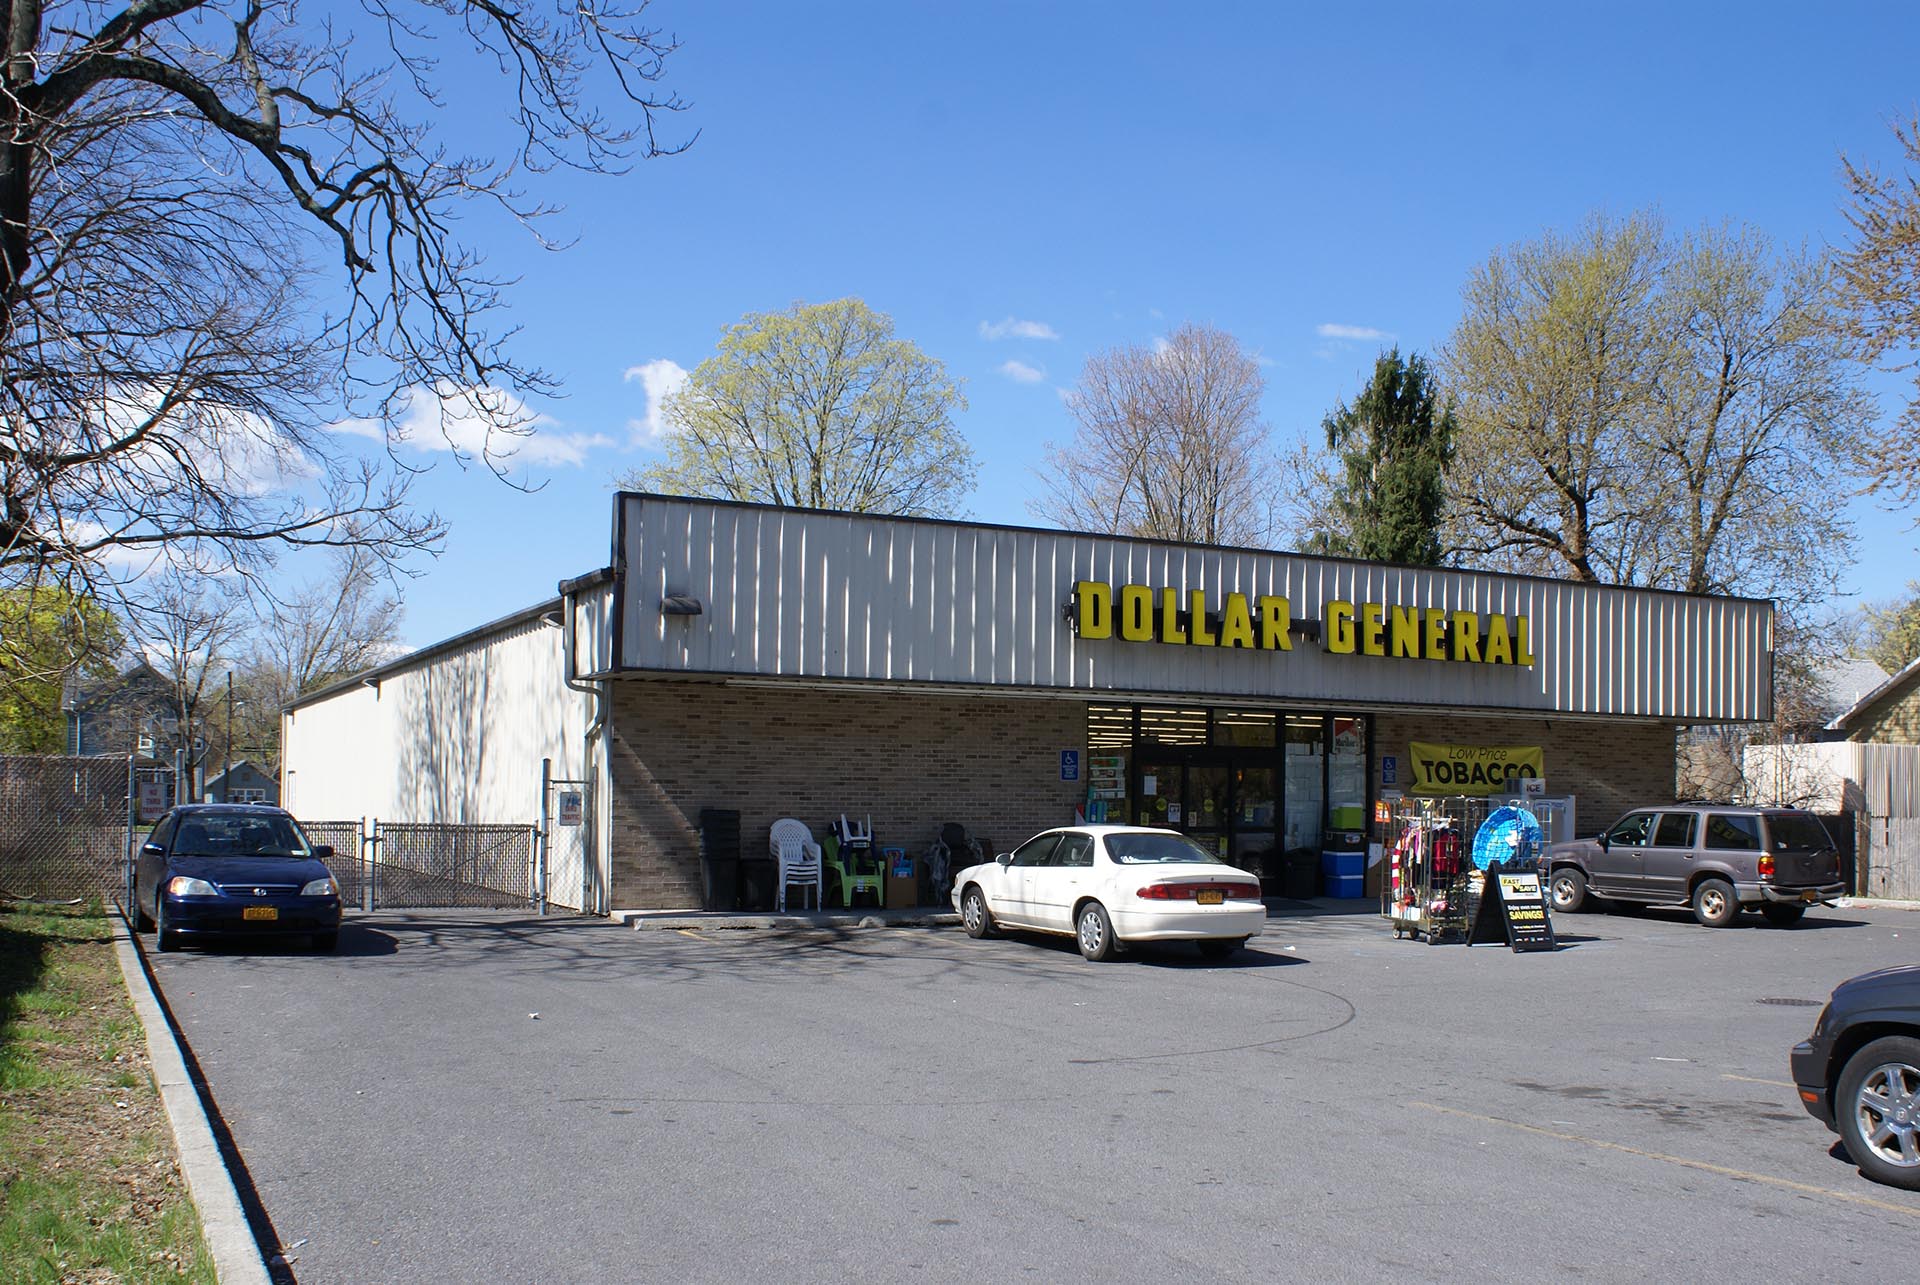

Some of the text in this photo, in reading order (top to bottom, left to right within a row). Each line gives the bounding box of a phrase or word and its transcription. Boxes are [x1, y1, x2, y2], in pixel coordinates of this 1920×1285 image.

[1076, 581, 1535, 666] DOLLAR GENERAL
[1448, 746, 1508, 761] Low Price
[1420, 760, 1537, 785] TOBACCO
[1526, 784, 1541, 792] ICE
[1509, 910, 1544, 920] SAVINGS!
